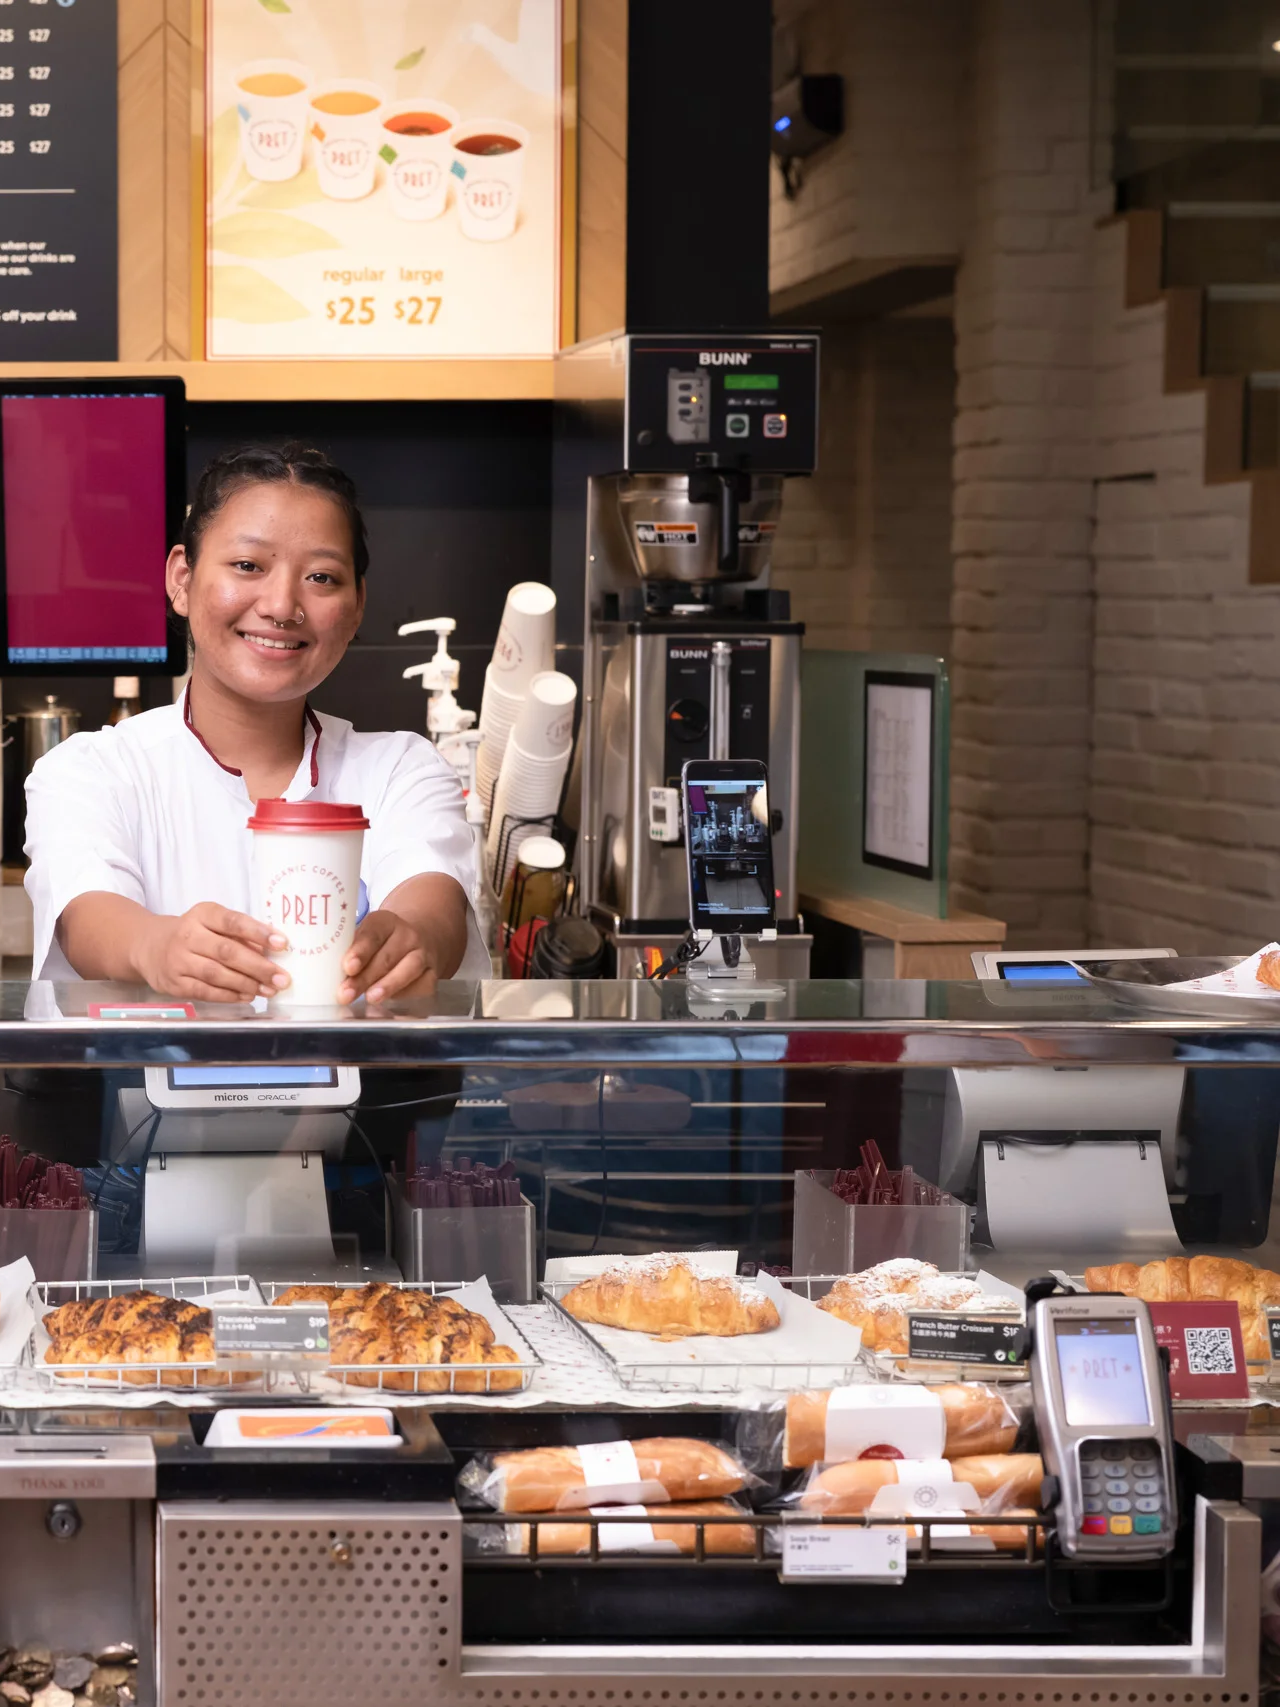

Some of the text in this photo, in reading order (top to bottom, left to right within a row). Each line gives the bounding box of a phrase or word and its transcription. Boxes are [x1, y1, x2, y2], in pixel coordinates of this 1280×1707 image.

[29, 28, 51, 43] $27
[29, 66, 51, 81] $27
[29, 103, 51, 117] $27
[29, 140, 51, 154] $27
[258, 131, 288, 148] PRET
[331, 149, 361, 166] PRET
[403, 171, 432, 188] PRET
[473, 191, 503, 208] PRET
[323, 267, 444, 285] regular large
[1, 310, 20, 321] off
[20, 312, 46, 324] your
[47, 309, 77, 321] drink
[326, 296, 443, 325] $25 $27
[699, 352, 748, 366] BUNN
[670, 649, 708, 659] BUNN
[312, 865, 346, 894] COFFEE
[282, 894, 331, 925] PRET
[214, 1092, 249, 1102] micros
[1050, 1307, 1090, 1315] Verifone
[912, 1320, 994, 1333] French Butter Croissant
[1082, 1358, 1118, 1379] PRET
[19, 1477, 67, 1490] THANK
[887, 1535, 900, 1545] $6
